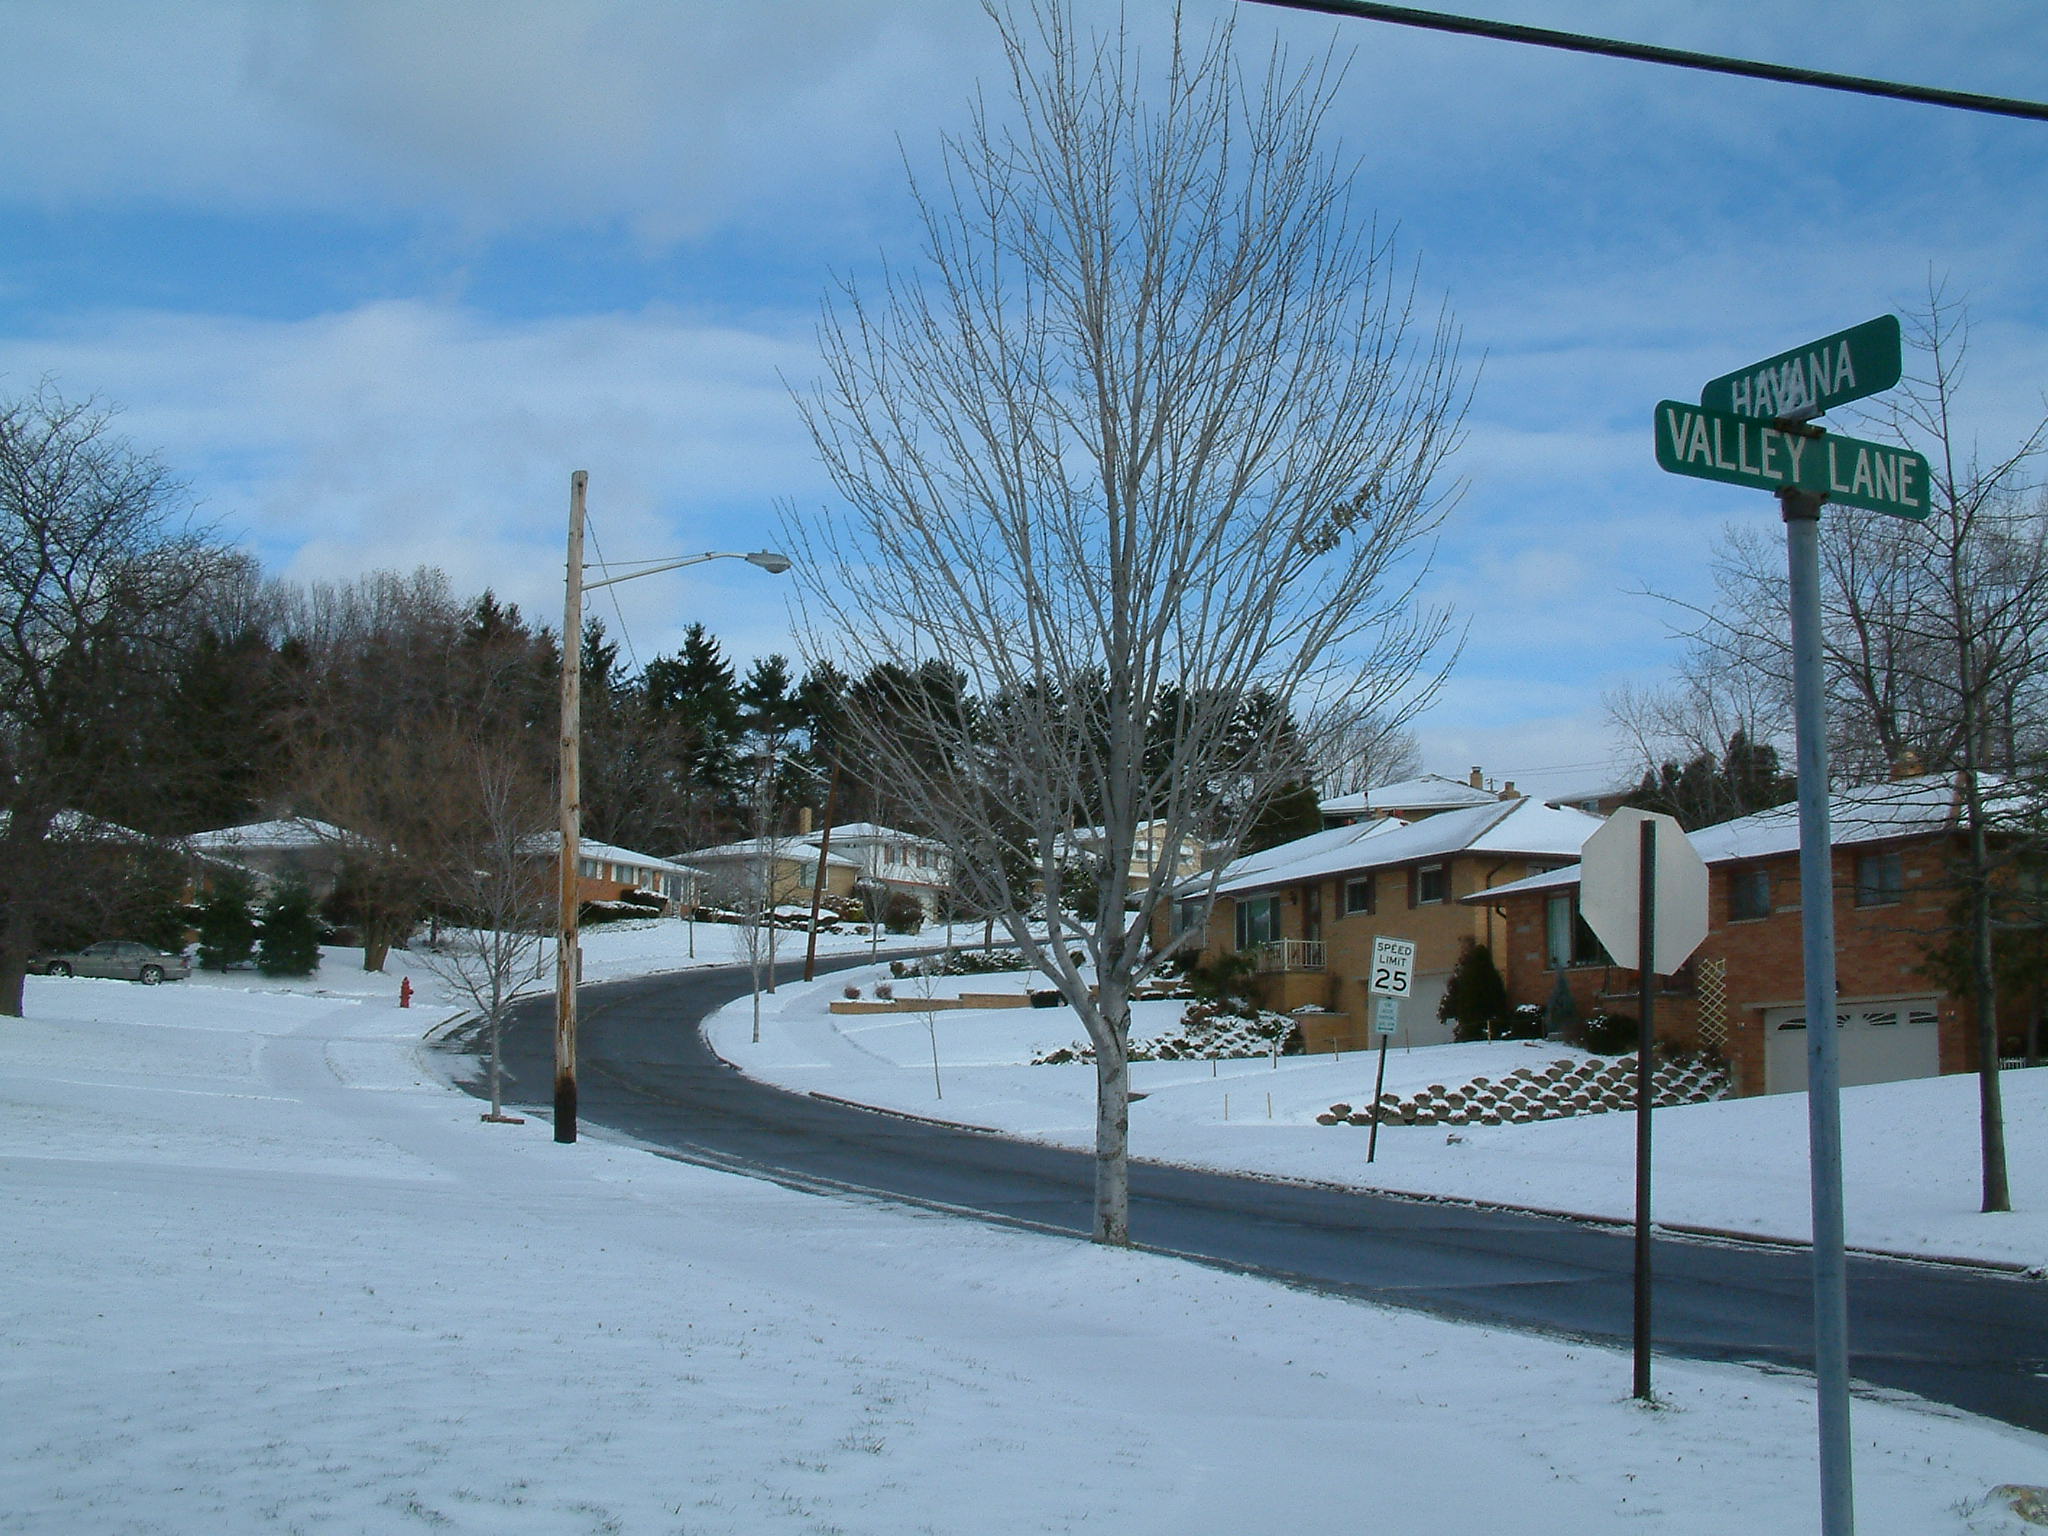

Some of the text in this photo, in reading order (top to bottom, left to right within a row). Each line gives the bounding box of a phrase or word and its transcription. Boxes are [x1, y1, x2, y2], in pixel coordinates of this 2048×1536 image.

[1732, 340, 1856, 418] HAVANA
[1667, 408, 1918, 507] VALLEY LANE
[1377, 943, 1412, 956] SPEED
[1379, 955, 1407, 967] LIMIT
[1375, 968, 1407, 991] 25
